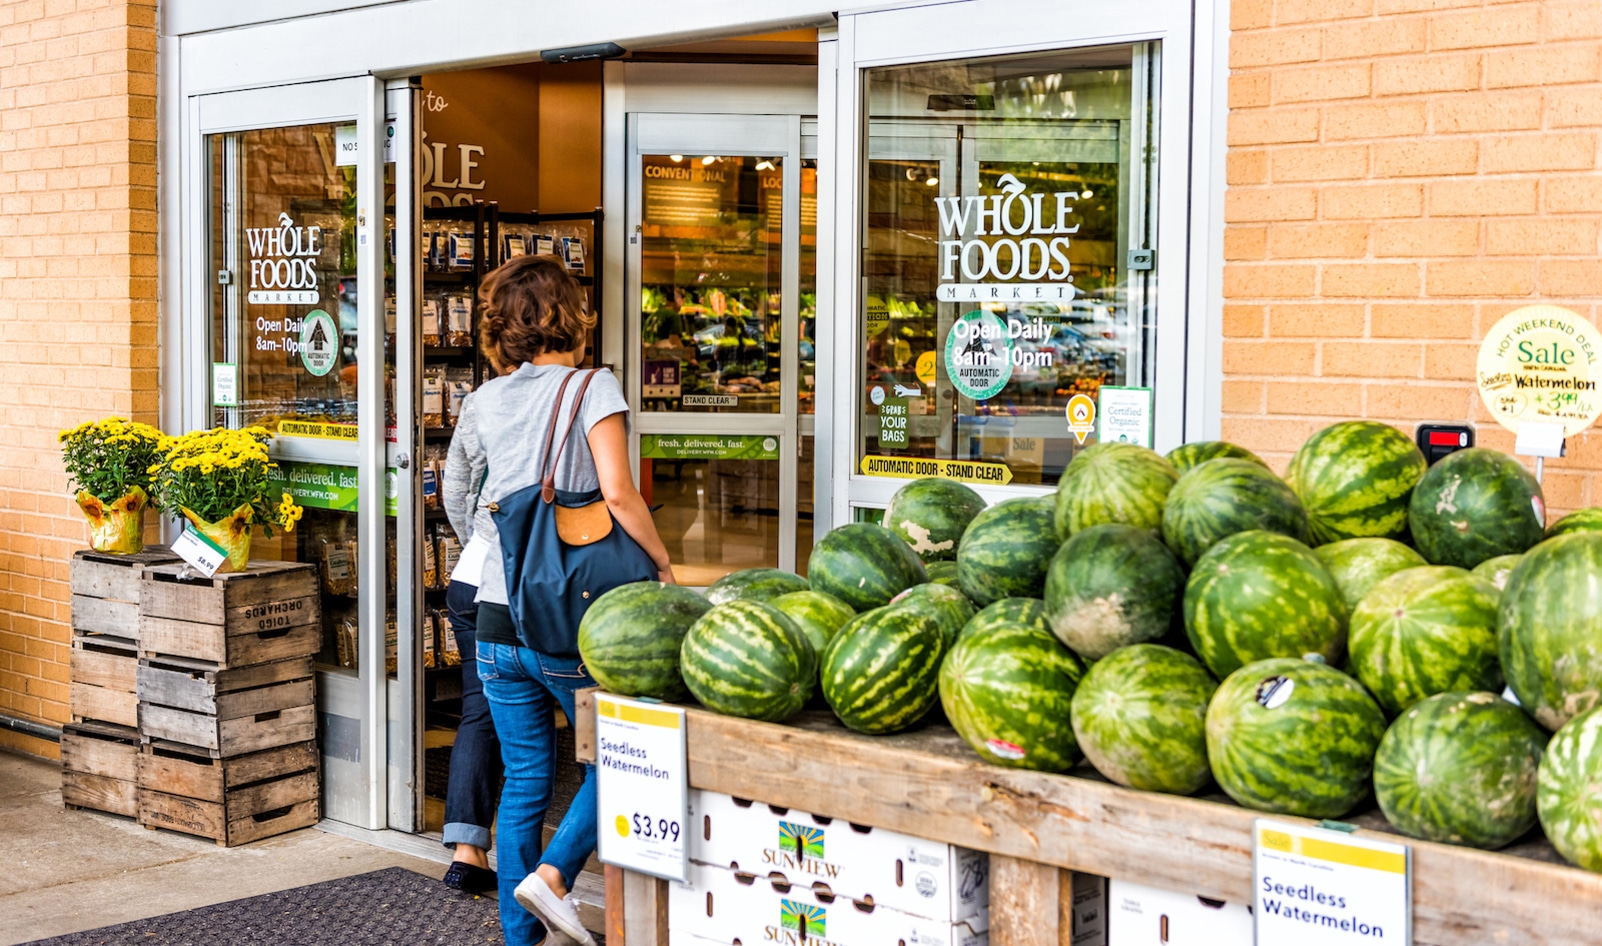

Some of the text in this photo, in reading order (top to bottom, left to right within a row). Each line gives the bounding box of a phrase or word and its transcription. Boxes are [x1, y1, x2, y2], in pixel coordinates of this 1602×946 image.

[426, 90, 448, 112] to
[342, 143, 353, 152] NO
[934, 182, 1080, 237] WHOLE
[245, 219, 321, 257] WHOLE
[941, 237, 1072, 281] FOODS
[250, 258, 318, 289] FOODS
[253, 293, 314, 302] MARKET
[947, 287, 1065, 298] MARKET
[256, 317, 308, 336] Open Daily
[954, 317, 1053, 345] Open Daily
[1496, 319, 1597, 365] HOT WEEKEND DEAL
[308, 352, 330, 360] AUTOMATIC
[1517, 341, 1575, 365] Sale
[959, 368, 1000, 377] AUTOMATIC
[969, 379, 989, 387] DOOR
[1514, 374, 1596, 391] Watermelon
[684, 396, 730, 405] STAND CLEAR
[885, 405, 902, 415] GRAB
[1108, 405, 1142, 416] Certified
[880, 416, 907, 429] YOUR
[1109, 415, 1140, 426] Organic
[281, 423, 308, 434] AUTOMATIC
[309, 424, 322, 435] DOOR
[326, 426, 341, 437] STAND
[343, 428, 358, 438] CLEAR
[882, 429, 905, 442] BAGS
[658, 439, 745, 449] fresh. delivered. fast.
[1013, 438, 1036, 451] Sale
[290, 468, 337, 487] delivered.
[868, 459, 914, 474] AUTOMATIC
[916, 462, 938, 475] DOOR
[946, 463, 973, 478] STAND
[975, 465, 1003, 481] CLEAR
[197, 556, 215, 571] $8.99
[245, 600, 303, 619] ORCHARDS
[601, 737, 647, 759] Seedless
[601, 754, 670, 780] Watermelon
[632, 812, 680, 842] $3.99
[1263, 876, 1346, 909] Seedless
[1262, 897, 1384, 938] Watermelon
